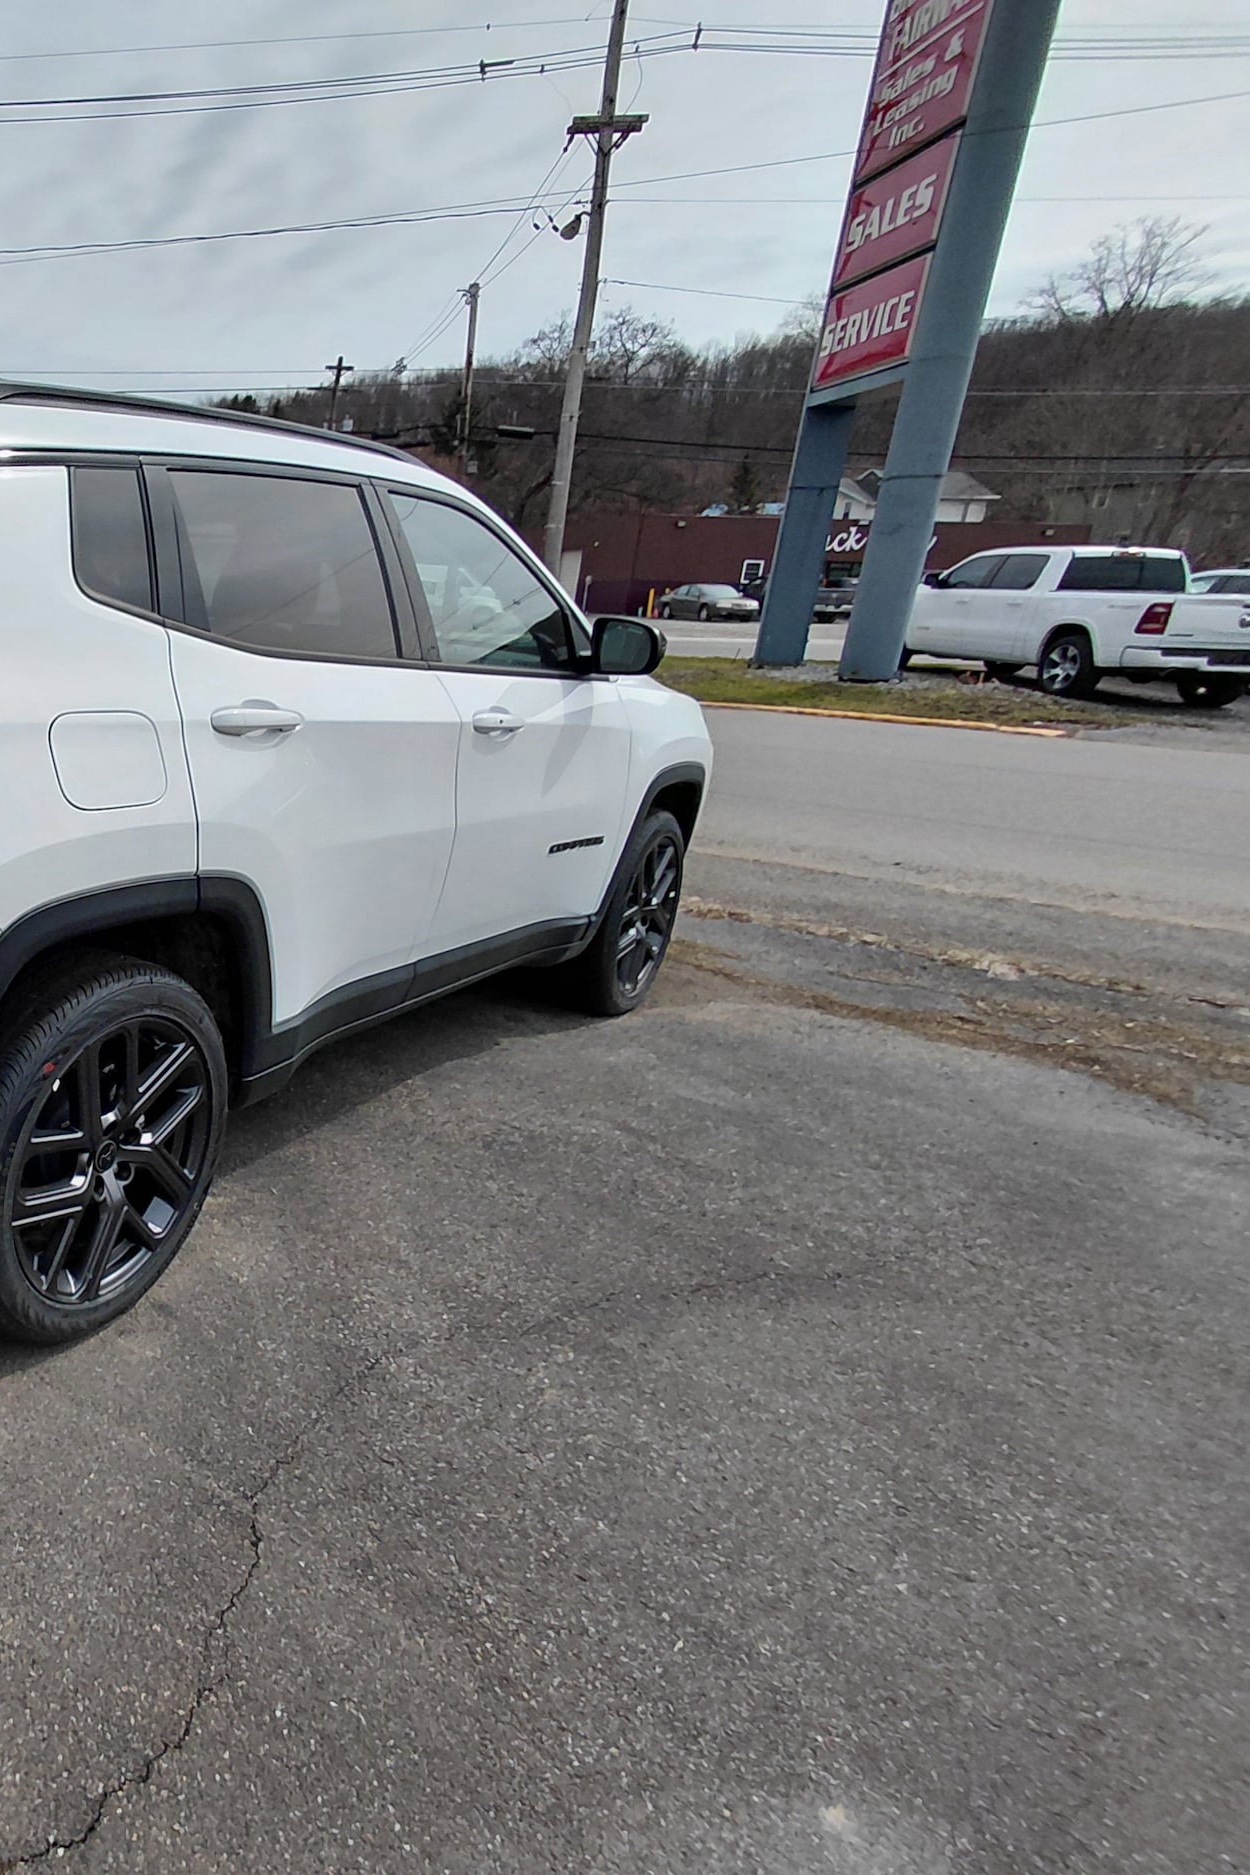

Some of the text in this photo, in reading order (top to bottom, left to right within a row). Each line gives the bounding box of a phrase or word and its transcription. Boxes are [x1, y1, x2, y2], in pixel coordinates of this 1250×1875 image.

[889, 0, 968, 60] FAIRW
[872, 65, 958, 137] Leasing
[878, 28, 966, 107] Sales &
[888, 115, 925, 151] Inc.
[845, 173, 937, 254] SALES
[819, 290, 915, 358] SERVICE
